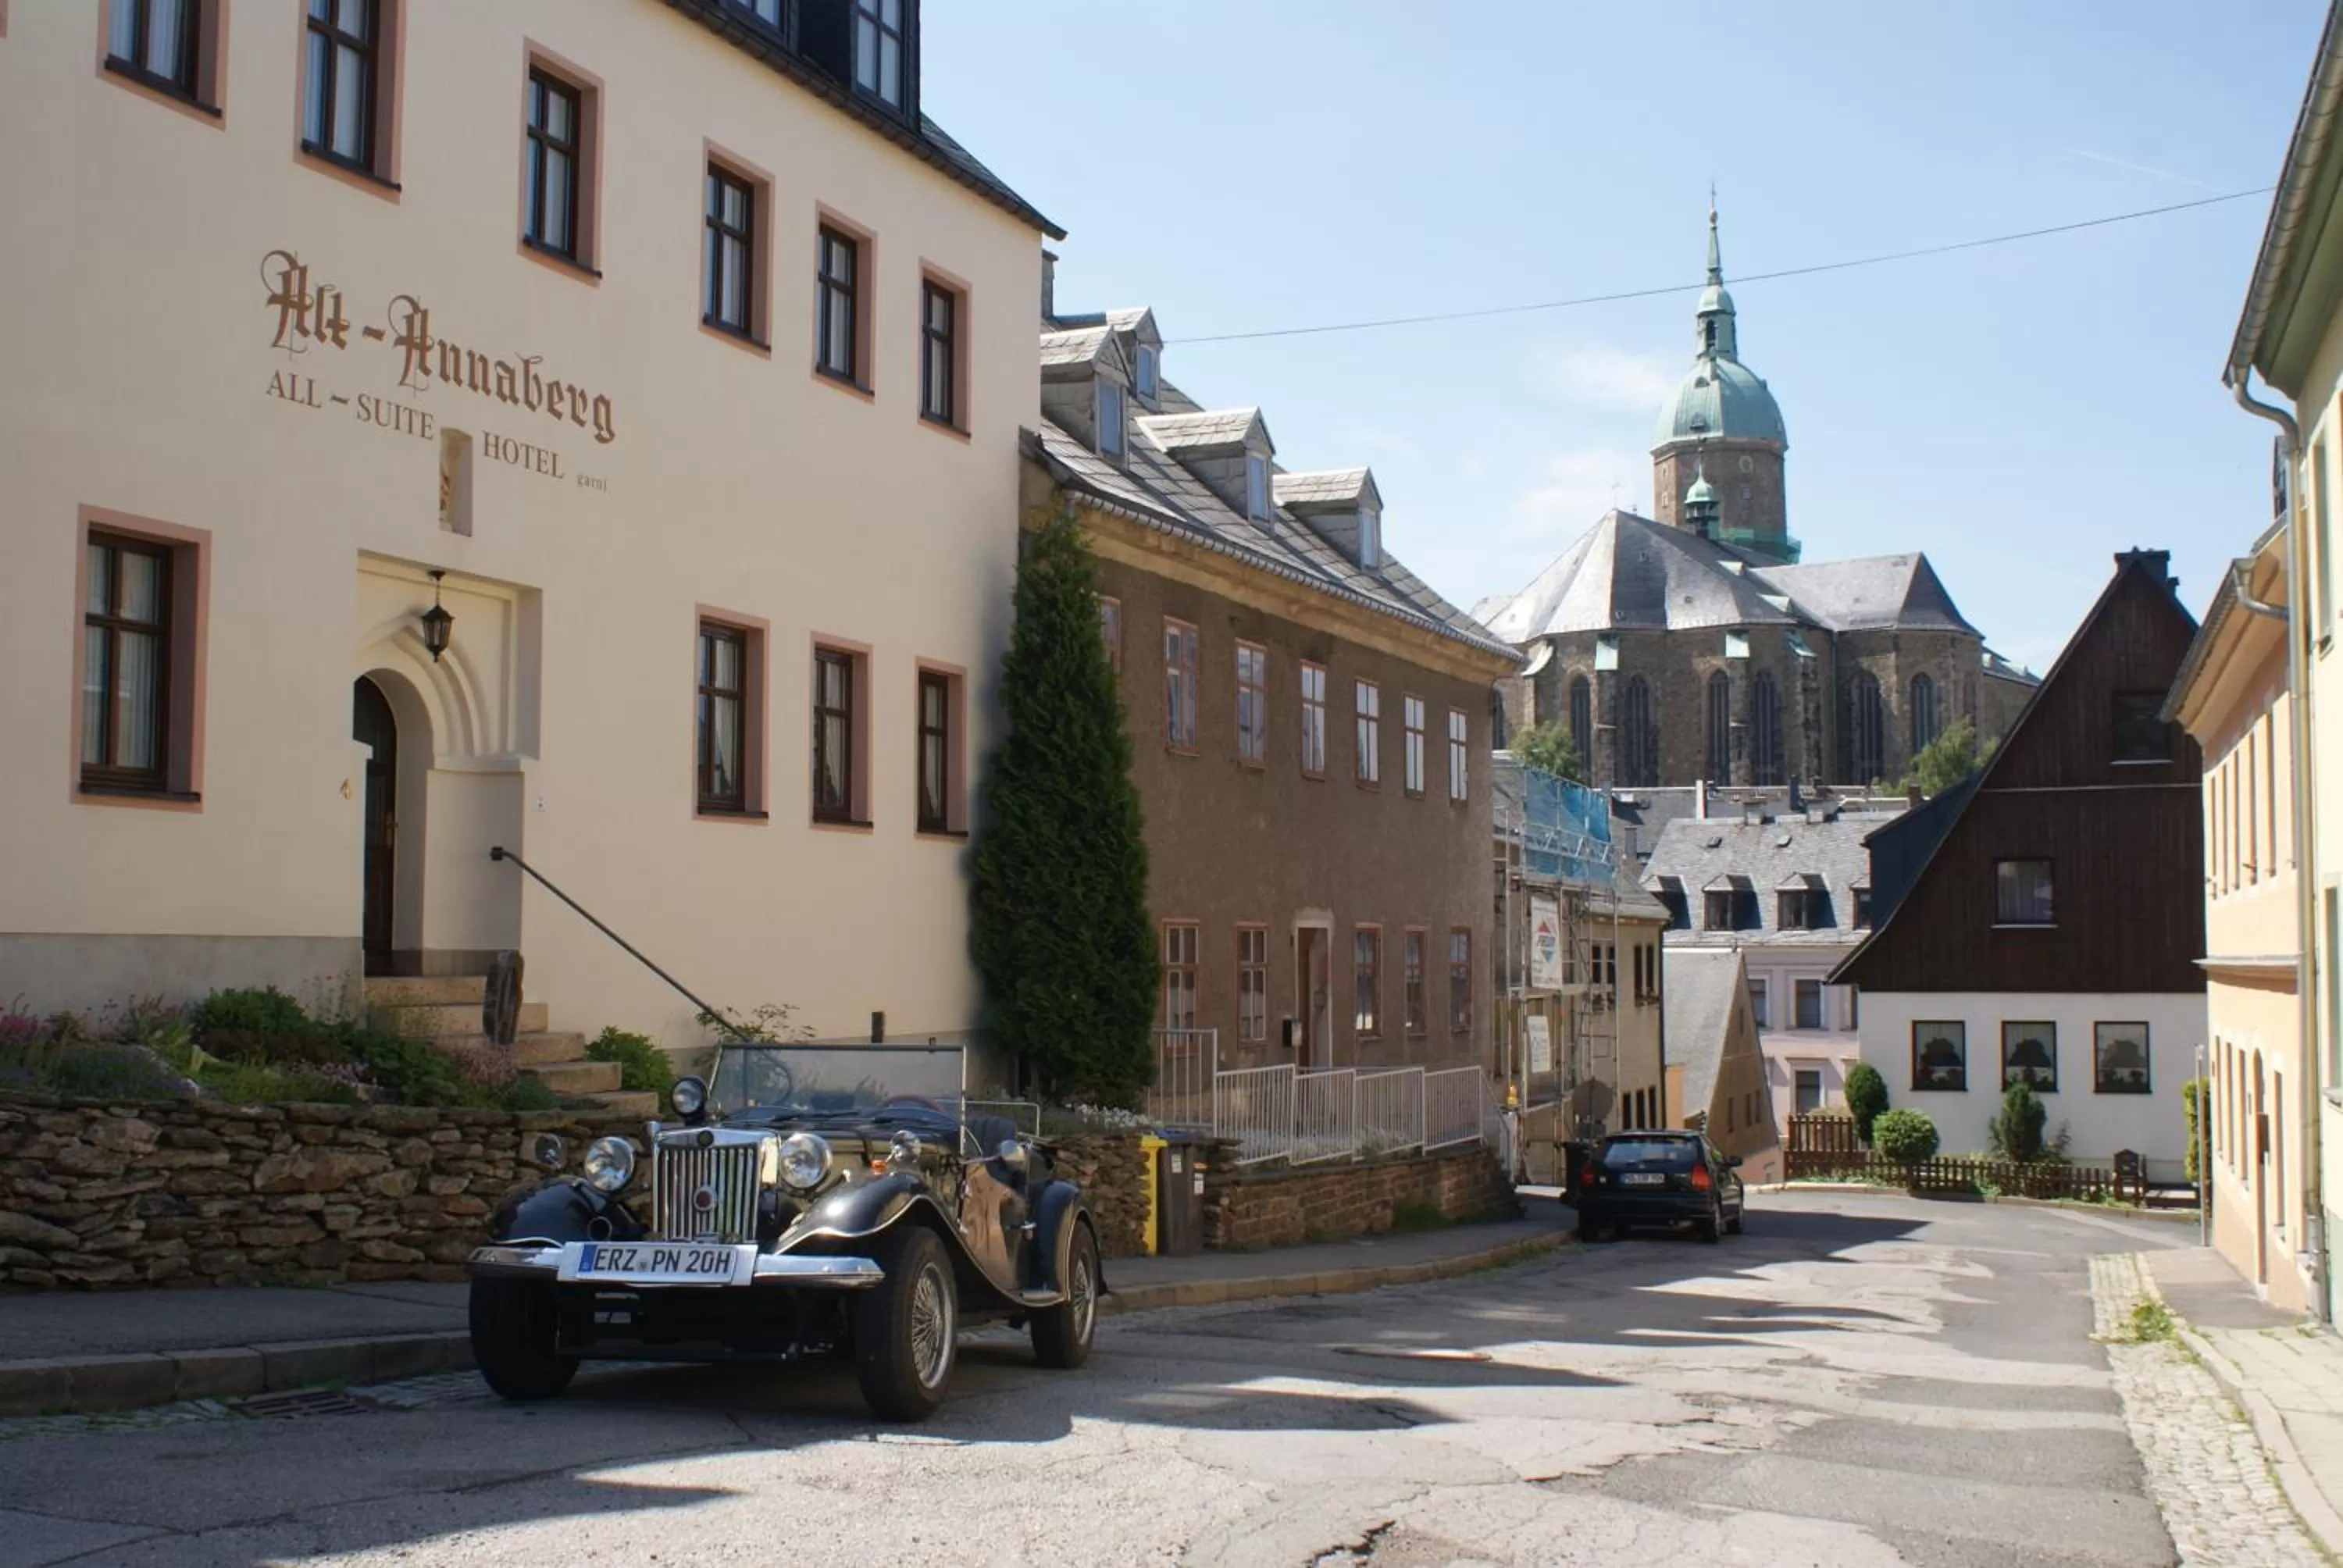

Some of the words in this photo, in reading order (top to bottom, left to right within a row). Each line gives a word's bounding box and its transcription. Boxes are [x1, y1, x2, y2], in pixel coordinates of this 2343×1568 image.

[482, 430, 565, 479] HOTEL
[594, 1249, 637, 1273] ERZ
[651, 1249, 681, 1273] PN
[686, 1250, 731, 1274] 20H
